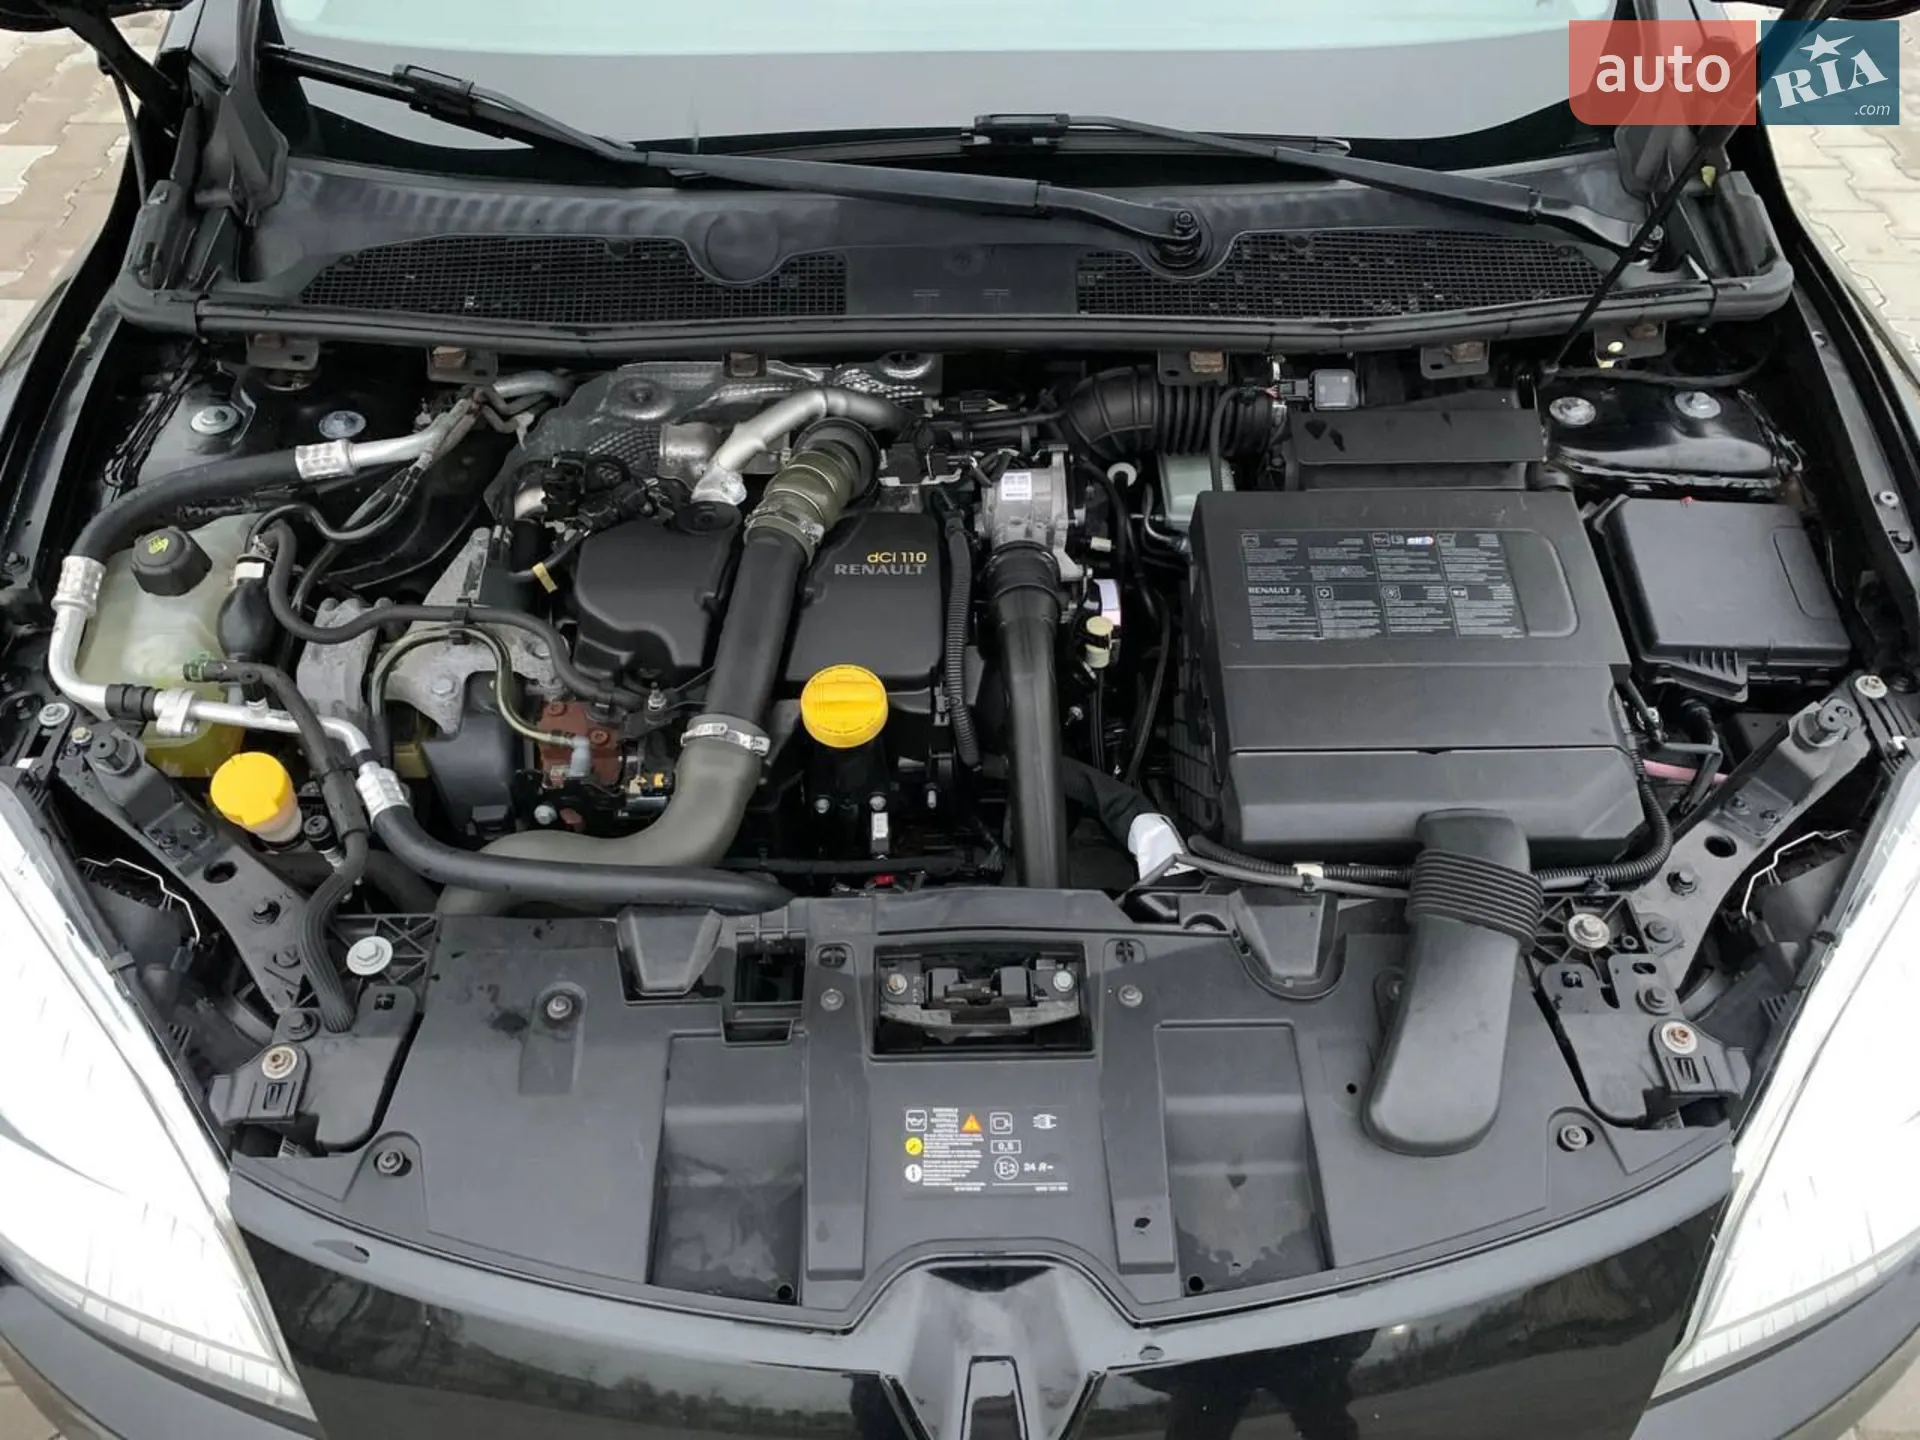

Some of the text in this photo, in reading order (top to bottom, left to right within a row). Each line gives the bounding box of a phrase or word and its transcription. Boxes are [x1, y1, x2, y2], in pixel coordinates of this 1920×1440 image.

[901, 551, 927, 563] 110
[834, 563, 927, 576] RENAULT
[1248, 586, 1291, 596] RENAULT
[999, 1161, 1017, 1175] E2
